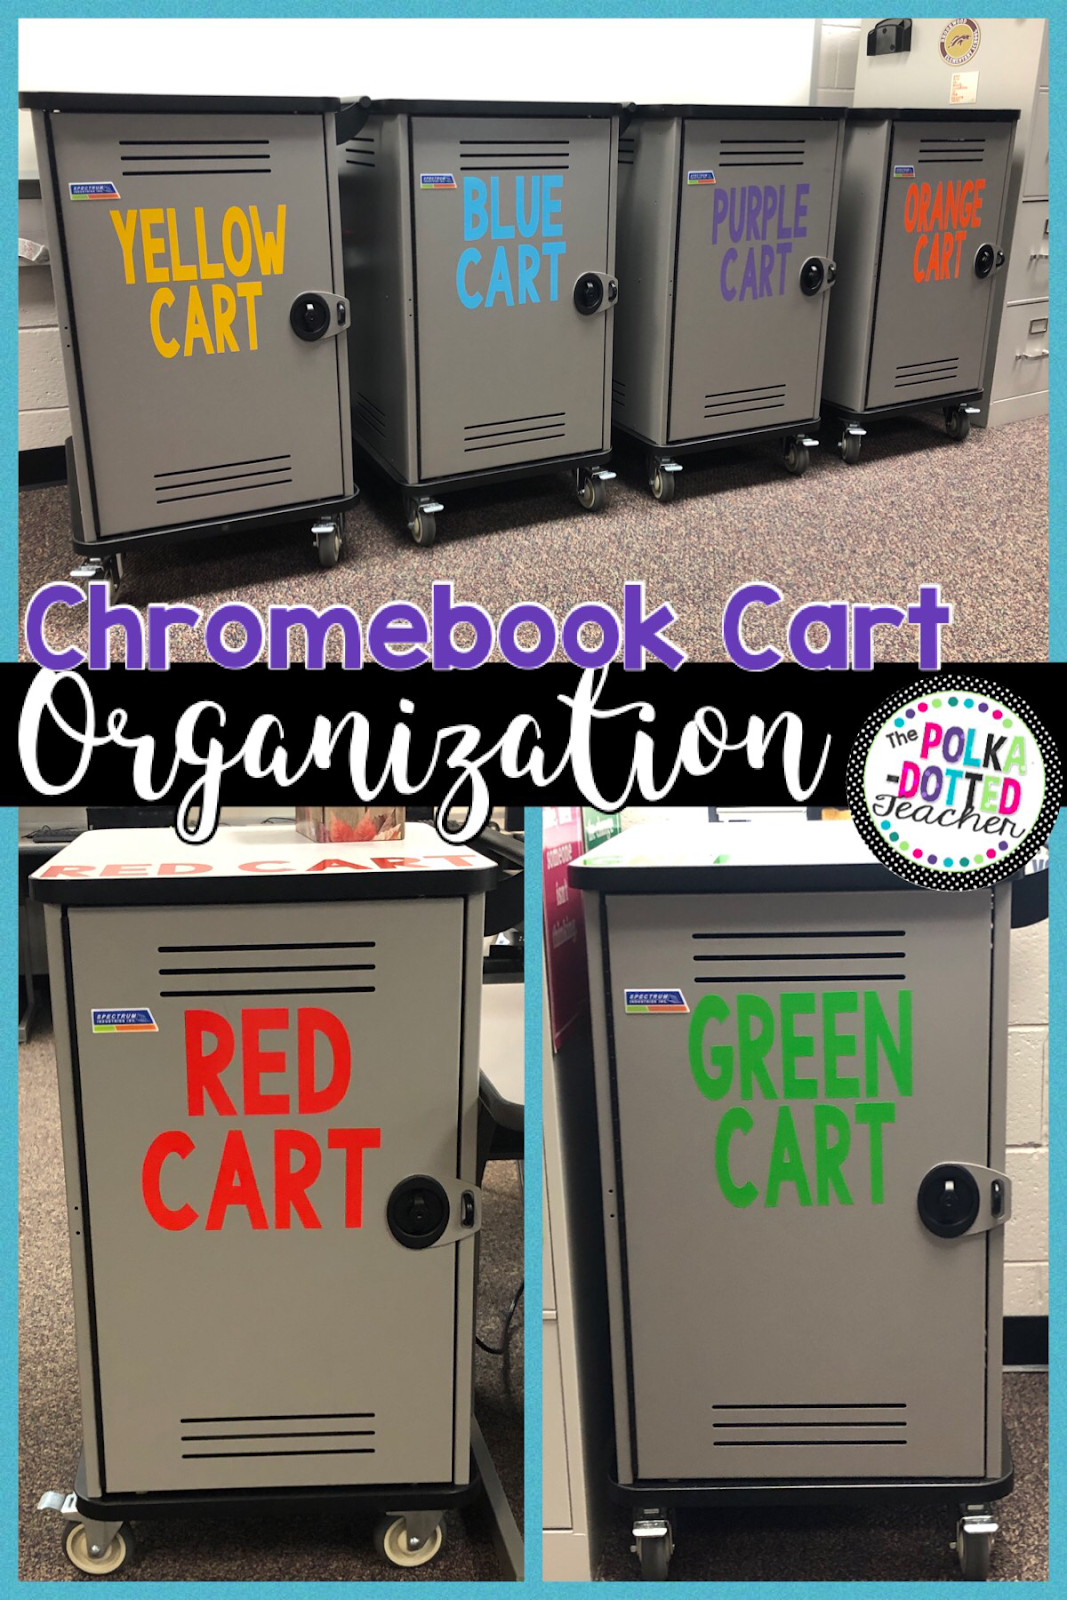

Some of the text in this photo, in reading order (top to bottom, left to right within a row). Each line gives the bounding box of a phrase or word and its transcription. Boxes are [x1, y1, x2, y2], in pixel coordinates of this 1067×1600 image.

[463, 175, 564, 241] BLUE
[712, 183, 810, 245] PURPLE
[904, 179, 986, 233] ORANGE
[110, 204, 286, 284] YELLOW
[456, 242, 566, 309] CART
[720, 242, 793, 302] CART
[914, 230, 967, 283] CART
[151, 280, 262, 358] CART
[40, 854, 476, 878] RED CART
[546, 842, 573, 870] someone
[185, 1008, 352, 1117] RED
[690, 990, 913, 1101] GREEN
[142, 1128, 381, 1231] CART
[715, 1101, 897, 1208] CART
